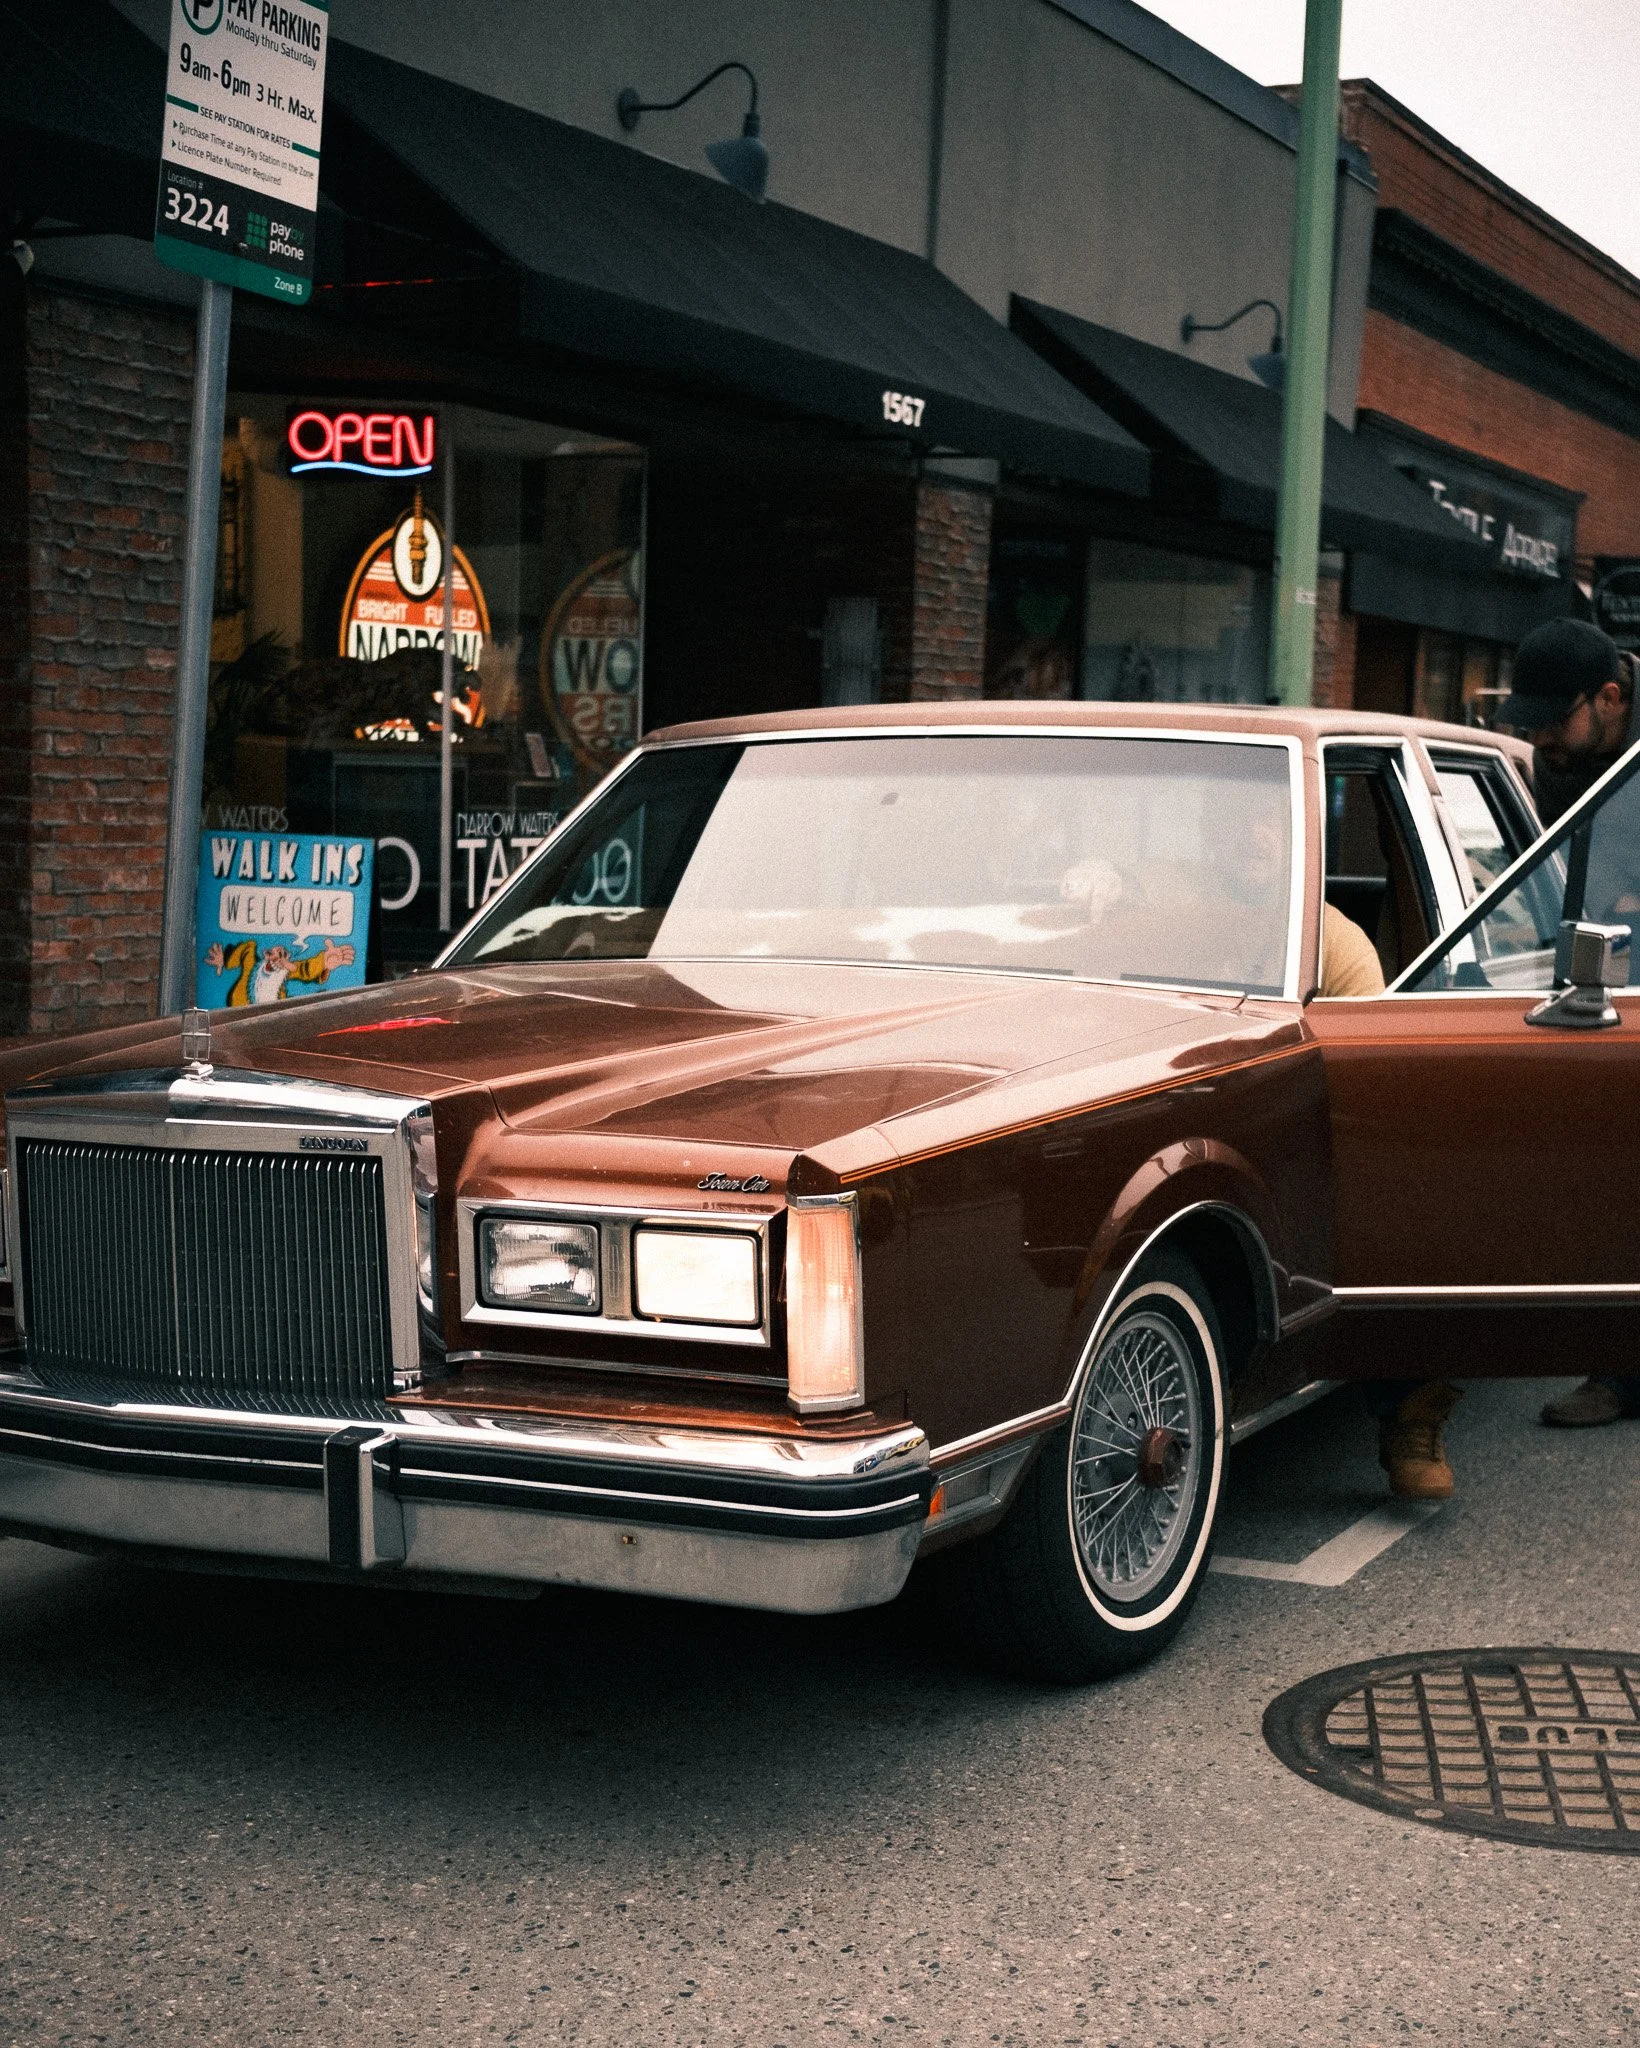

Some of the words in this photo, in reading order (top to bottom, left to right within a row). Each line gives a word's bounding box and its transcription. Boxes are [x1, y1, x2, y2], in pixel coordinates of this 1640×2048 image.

[261, 0, 321, 51] PARKING
[226, 19, 260, 47] Monday
[261, 35, 279, 52] thru
[281, 43, 317, 71] Saturday
[256, 83, 264, 102] 3
[267, 88, 285, 111] Hr.
[288, 96, 317, 123] Max.
[200, 106, 213, 120] SEE
[214, 111, 228, 126] PAY
[227, 118, 256, 136] STATION
[256, 127, 270, 140] FOR
[270, 132, 291, 149] RATES
[178, 121, 209, 141] Purchase
[211, 133, 226, 147] Time
[227, 138, 234, 150] at
[235, 143, 246, 156] any
[247, 146, 258, 161] Pay
[259, 151, 280, 167] Station
[281, 158, 288, 169] in
[288, 160, 298, 173] the
[299, 166, 314, 179] Zone
[178, 141, 205, 159] Licence
[205, 150, 223, 165] Plate
[224, 157, 252, 175] Number
[252, 167, 282, 186] Required
[167, 169, 197, 188] Location
[165, 187, 229, 236] 3224
[269, 238, 305, 261] phone
[274, 276, 295, 294] Zone
[296, 283, 303, 295] B
[882, 390, 925, 427] 1567
[288, 411, 434, 466] OPEN
[357, 598, 409, 622] BRIGHT
[424, 604, 478, 629] FULED
[218, 805, 290, 833] WATERS
[457, 812, 515, 837] NARROW
[211, 837, 299, 882] WALK
[311, 843, 364, 885] INS
[226, 894, 341, 928] WELCOME
[299, 1136, 369, 1152] LINCOLN
[697, 1171, 740, 1191] Town
[741, 1173, 770, 1193] Car
